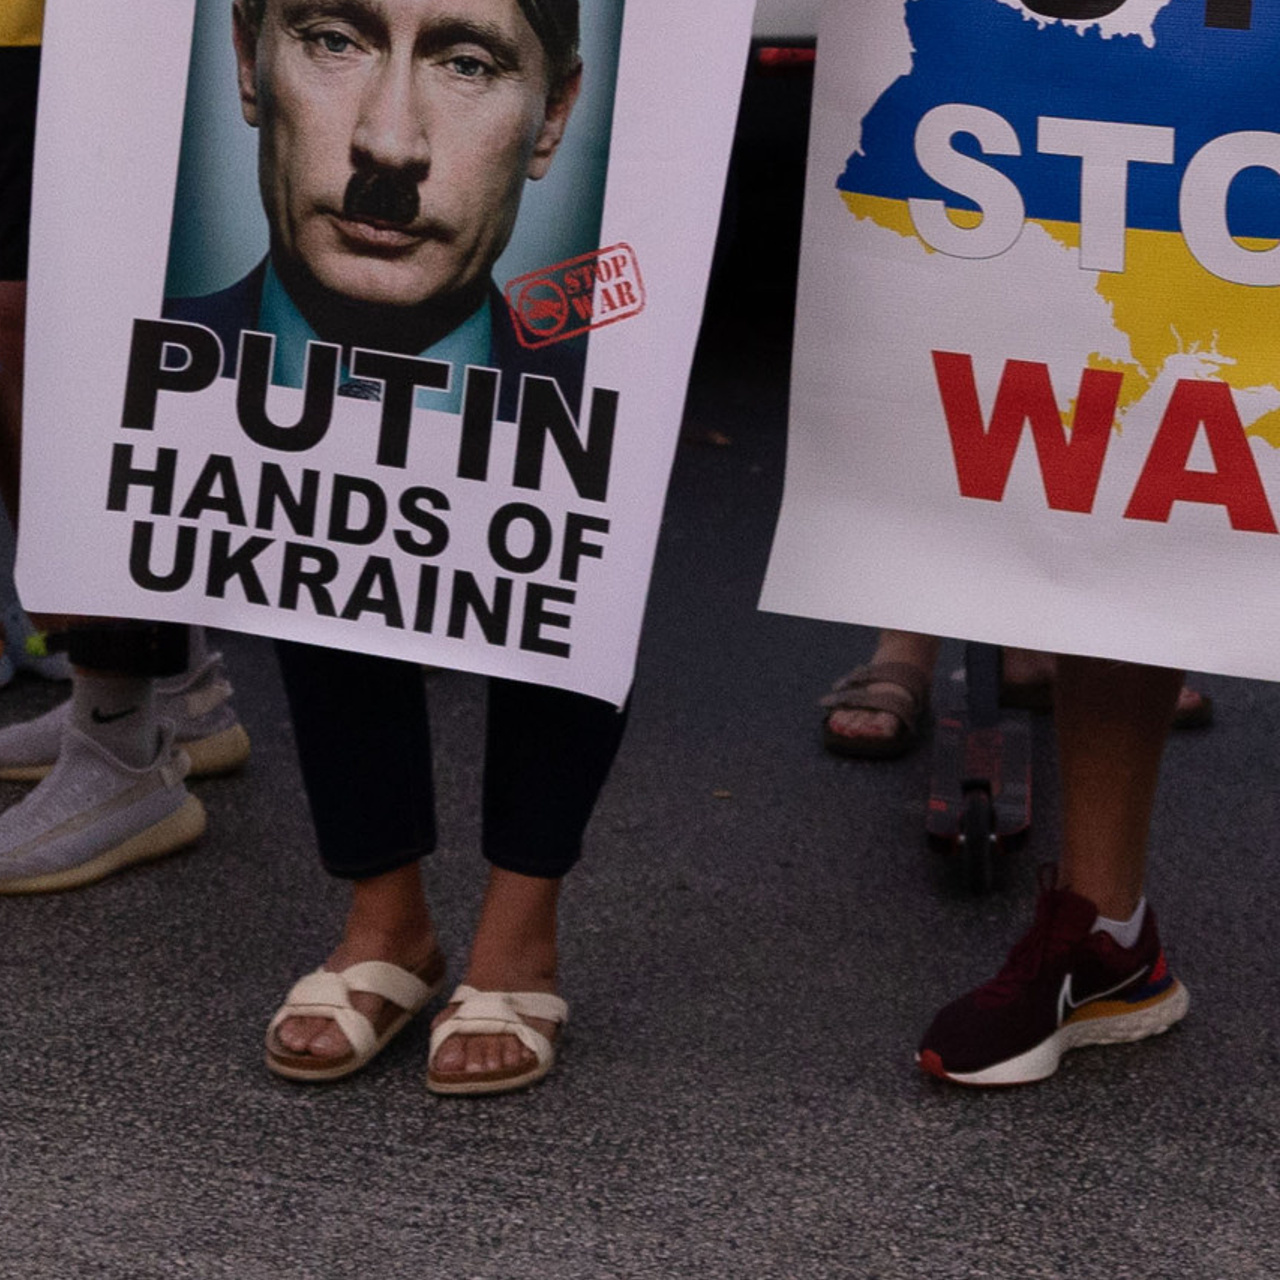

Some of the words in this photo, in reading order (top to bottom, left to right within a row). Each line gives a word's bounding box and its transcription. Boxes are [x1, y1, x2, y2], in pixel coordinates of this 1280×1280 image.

[563, 254, 627, 294] STOP
[572, 281, 637, 319] WAR
[121, 318, 619, 503] PUTIN
[106, 442, 450, 557] HANDS
[488, 502, 610, 582] OF
[129, 520, 576, 659] UKRAINE
